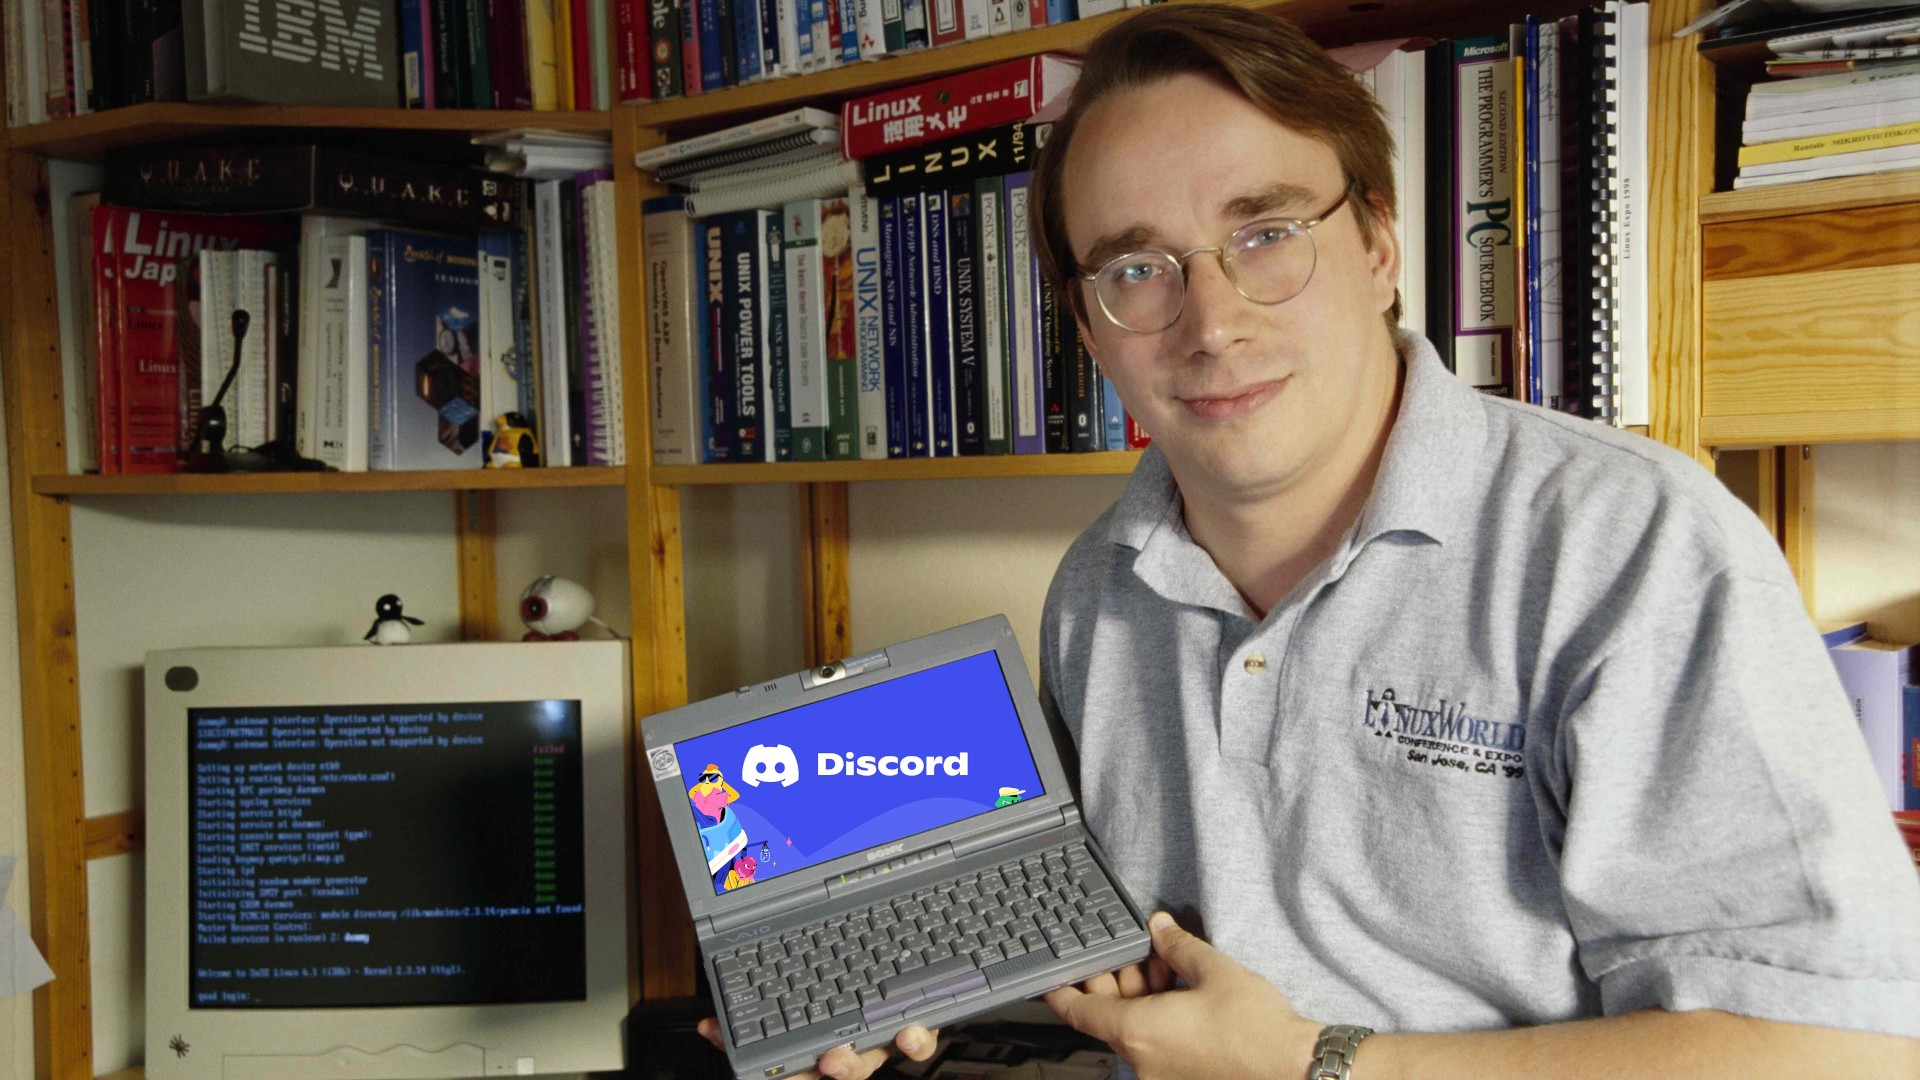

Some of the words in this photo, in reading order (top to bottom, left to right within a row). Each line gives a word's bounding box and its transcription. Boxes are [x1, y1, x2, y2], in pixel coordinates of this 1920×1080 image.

[239, 0, 385, 81] IBM
[1463, 42, 1509, 58] Microsoft
[1478, 67, 1493, 93] THE
[852, 94, 922, 127] Linux
[1498, 90, 1507, 130] SECOND
[872, 138, 998, 184] LINUX
[1012, 122, 1026, 165] 11/94
[1478, 96, 1493, 197] PROGRAMMER'S
[1499, 133, 1507, 174] EDITION
[907, 217, 916, 252] TCP/IP
[931, 214, 940, 238] DNS
[1012, 191, 1026, 250] POSIX
[1466, 199, 1511, 248] PC
[1623, 204, 1631, 227] Expo
[707, 226, 723, 304] UNIX
[883, 222, 894, 277] Managing
[932, 240, 940, 262] and
[660, 261, 669, 317] OpenVMS
[737, 252, 751, 293] UNIX
[857, 247, 878, 314] UNIX
[886, 280, 896, 301] NFS
[908, 255, 919, 298] Network
[933, 265, 942, 295] BIND
[957, 257, 972, 295] UNIX
[1479, 237, 1495, 321] SOURCEBOOK
[739, 298, 753, 359] POWER
[775, 314, 783, 344] UNIX
[887, 303, 896, 324] and
[959, 298, 974, 352] SYSTEM
[776, 346, 783, 357] in
[860, 317, 869, 392] PROGRAMMING
[868, 316, 880, 392] NETWORK
[889, 327, 898, 346] NIS
[909, 300, 920, 378] Administration
[1043, 317, 1053, 358] Operating
[138, 359, 177, 374] Linux
[961, 355, 975, 366] V
[1045, 359, 1054, 388] System
[741, 363, 755, 416] TOOLS
[777, 368, 786, 412] Nutshell
[817, 751, 969, 777] Discord
[1397, 735, 1470, 755] CONFERENCE
[1472, 749, 1482, 758] &
[1485, 750, 1523, 763] EXPO
[1406, 749, 1429, 764] San
[1431, 752, 1470, 772] Jose,
[1474, 762, 1497, 775] CA
[1502, 765, 1525, 779] '99
[725, 925, 771, 943] VAIO
